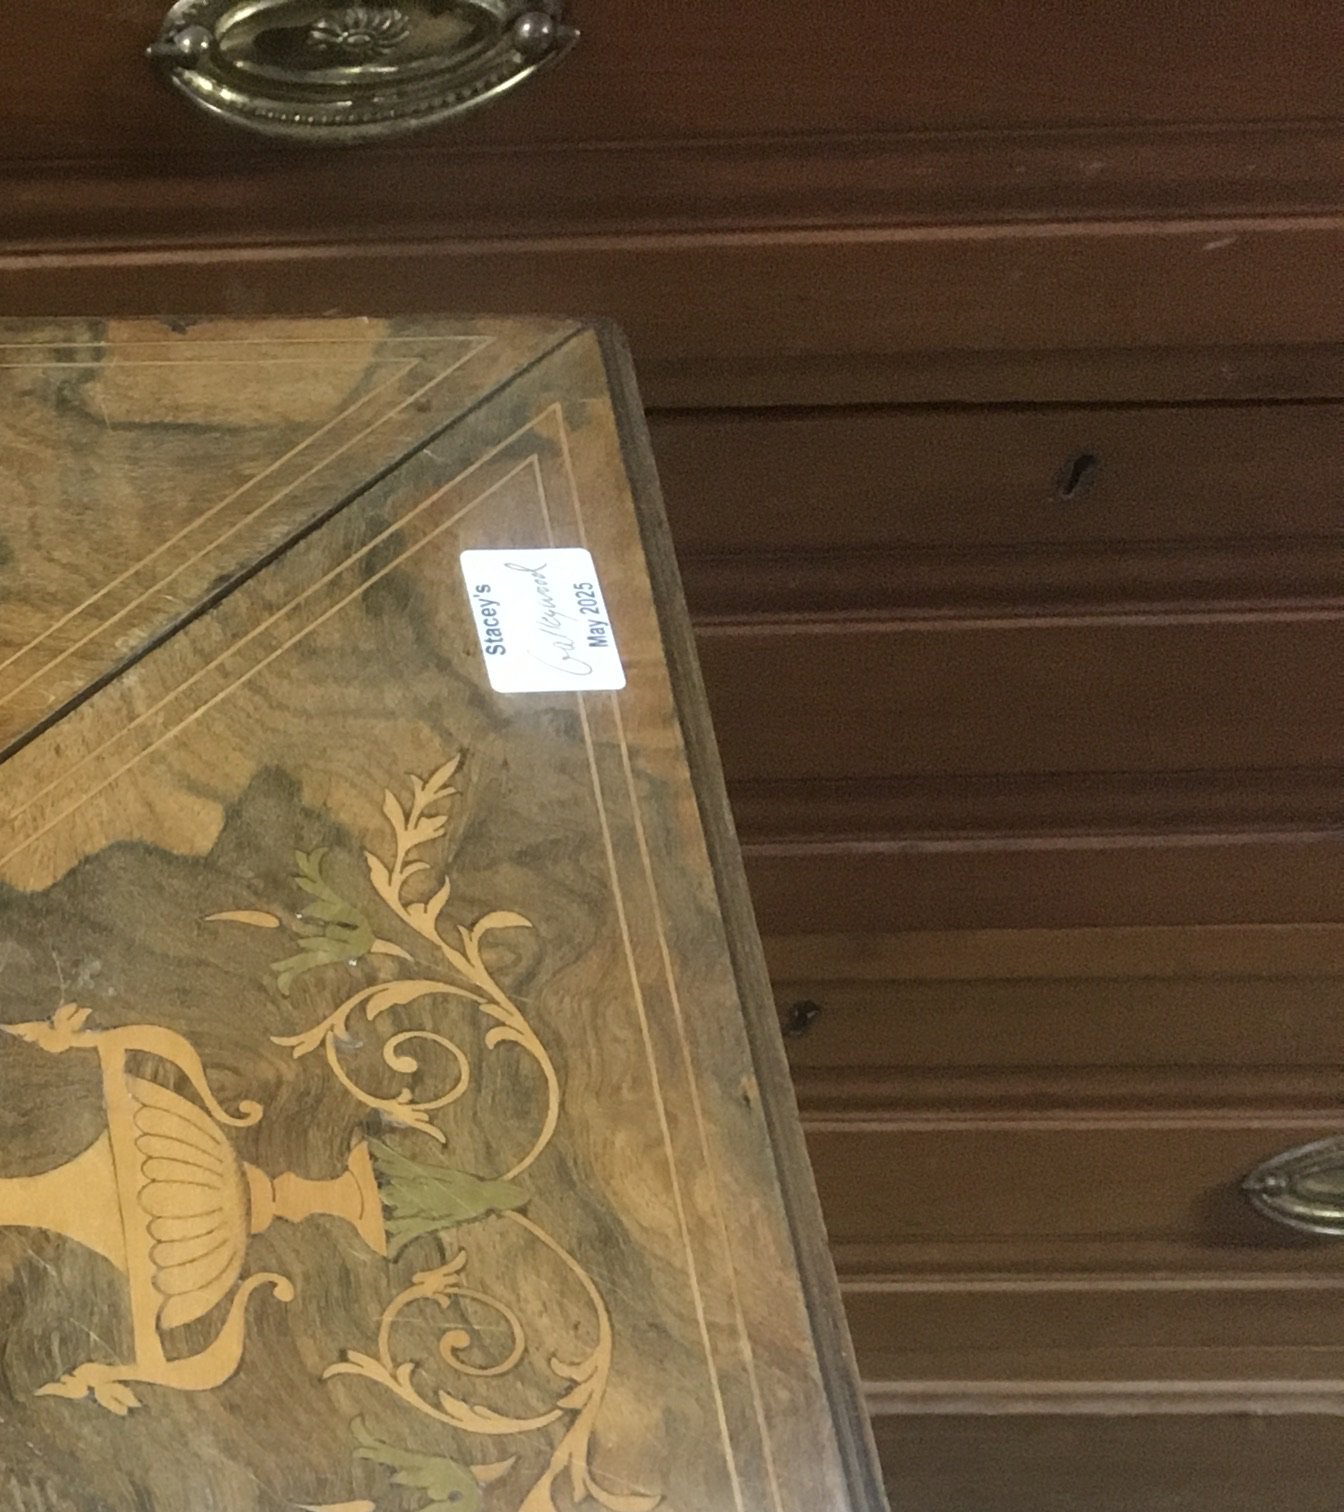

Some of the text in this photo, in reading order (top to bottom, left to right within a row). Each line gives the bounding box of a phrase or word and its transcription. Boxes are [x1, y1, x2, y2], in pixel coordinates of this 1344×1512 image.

[473, 583, 507, 656] Stacey's
[573, 582, 609, 648] May 2025
